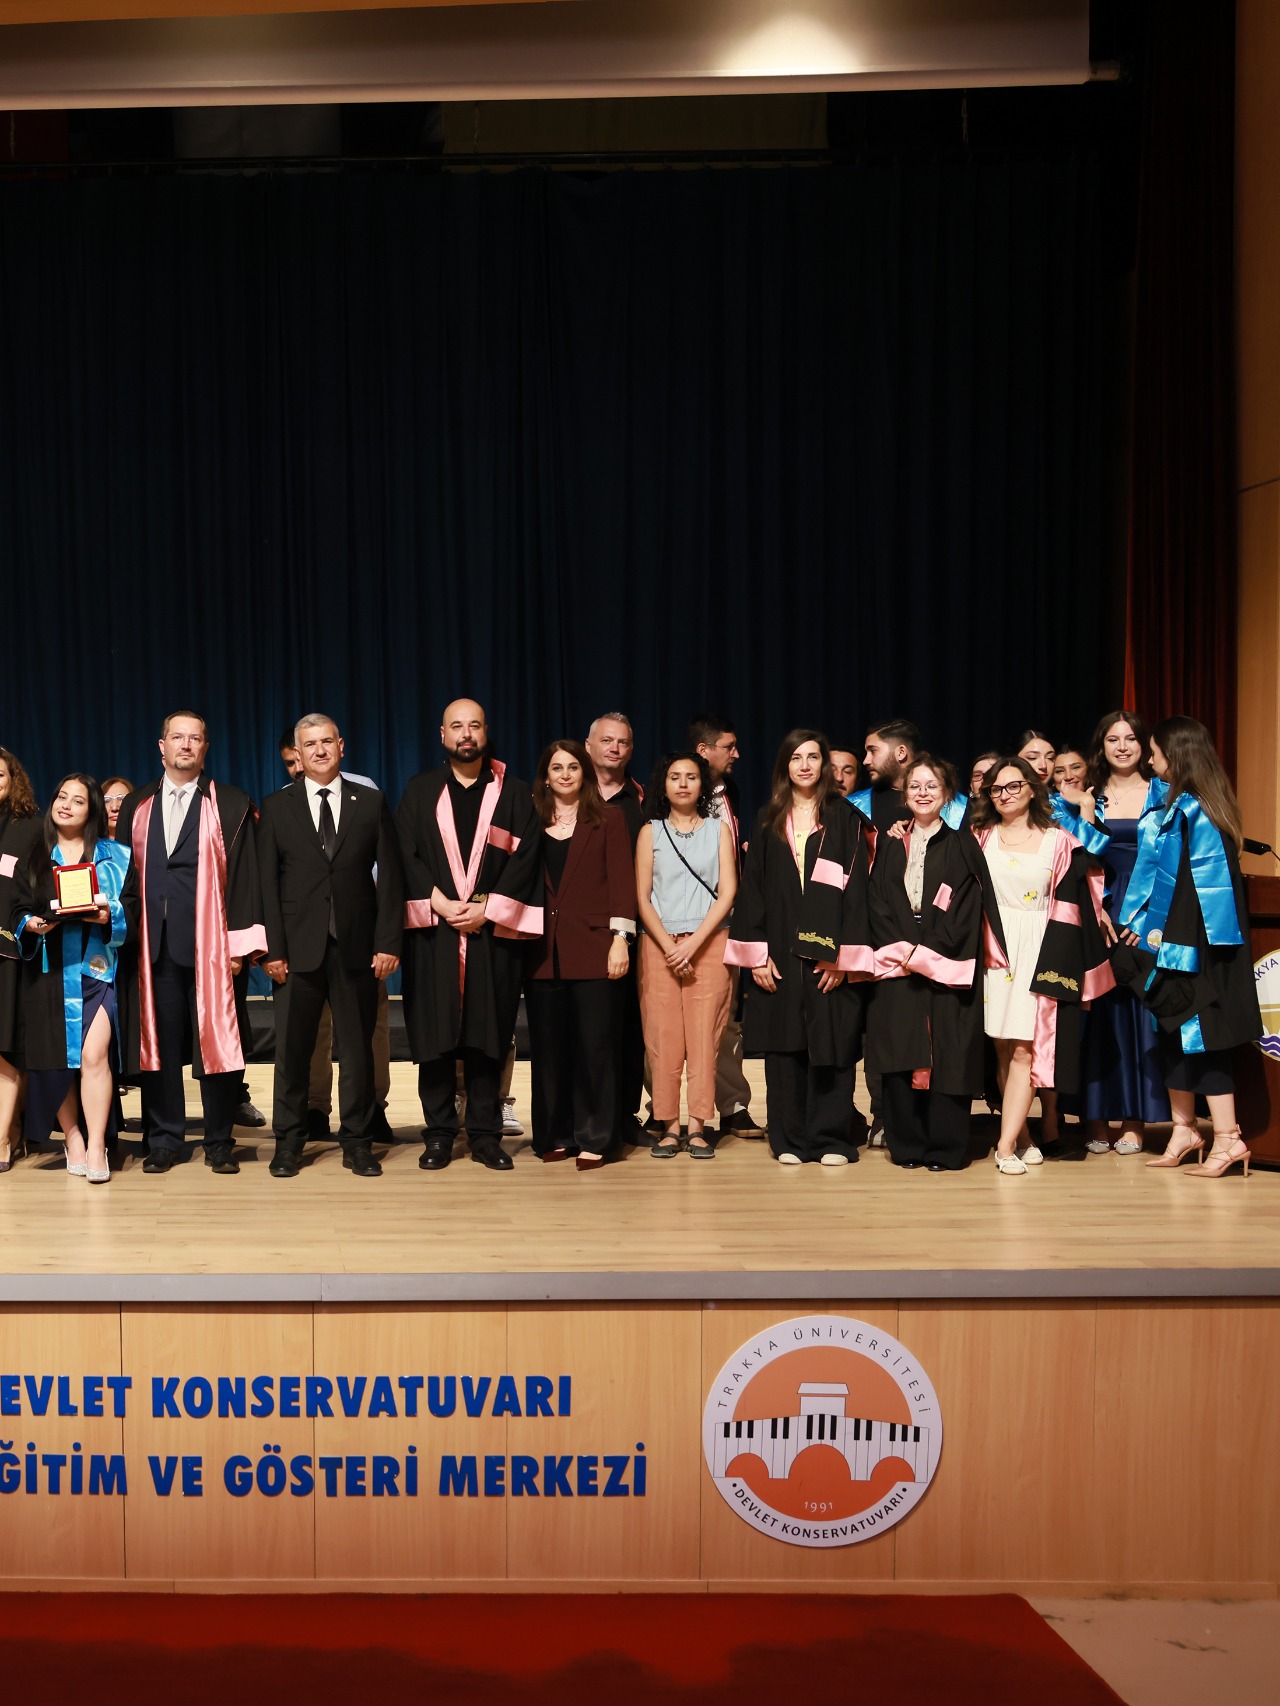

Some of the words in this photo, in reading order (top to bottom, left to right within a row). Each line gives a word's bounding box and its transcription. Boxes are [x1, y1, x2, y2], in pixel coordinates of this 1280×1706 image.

[1254, 958, 1279, 981] KYA
[717, 1340, 778, 1409] TRAKYA
[793, 1325, 931, 1413] ÜNİVERSİTESİ
[151, 1375, 572, 1418] KONSERVATUVARI
[148, 1455, 203, 1496] VE
[223, 1443, 418, 1497] GÖSTERİ
[439, 1442, 647, 1497] MERKEZİ
[734, 1488, 779, 1528] DEVLET
[781, 1492, 905, 1539] KONSERVATUVARI
[803, 1500, 833, 1513] 1991
